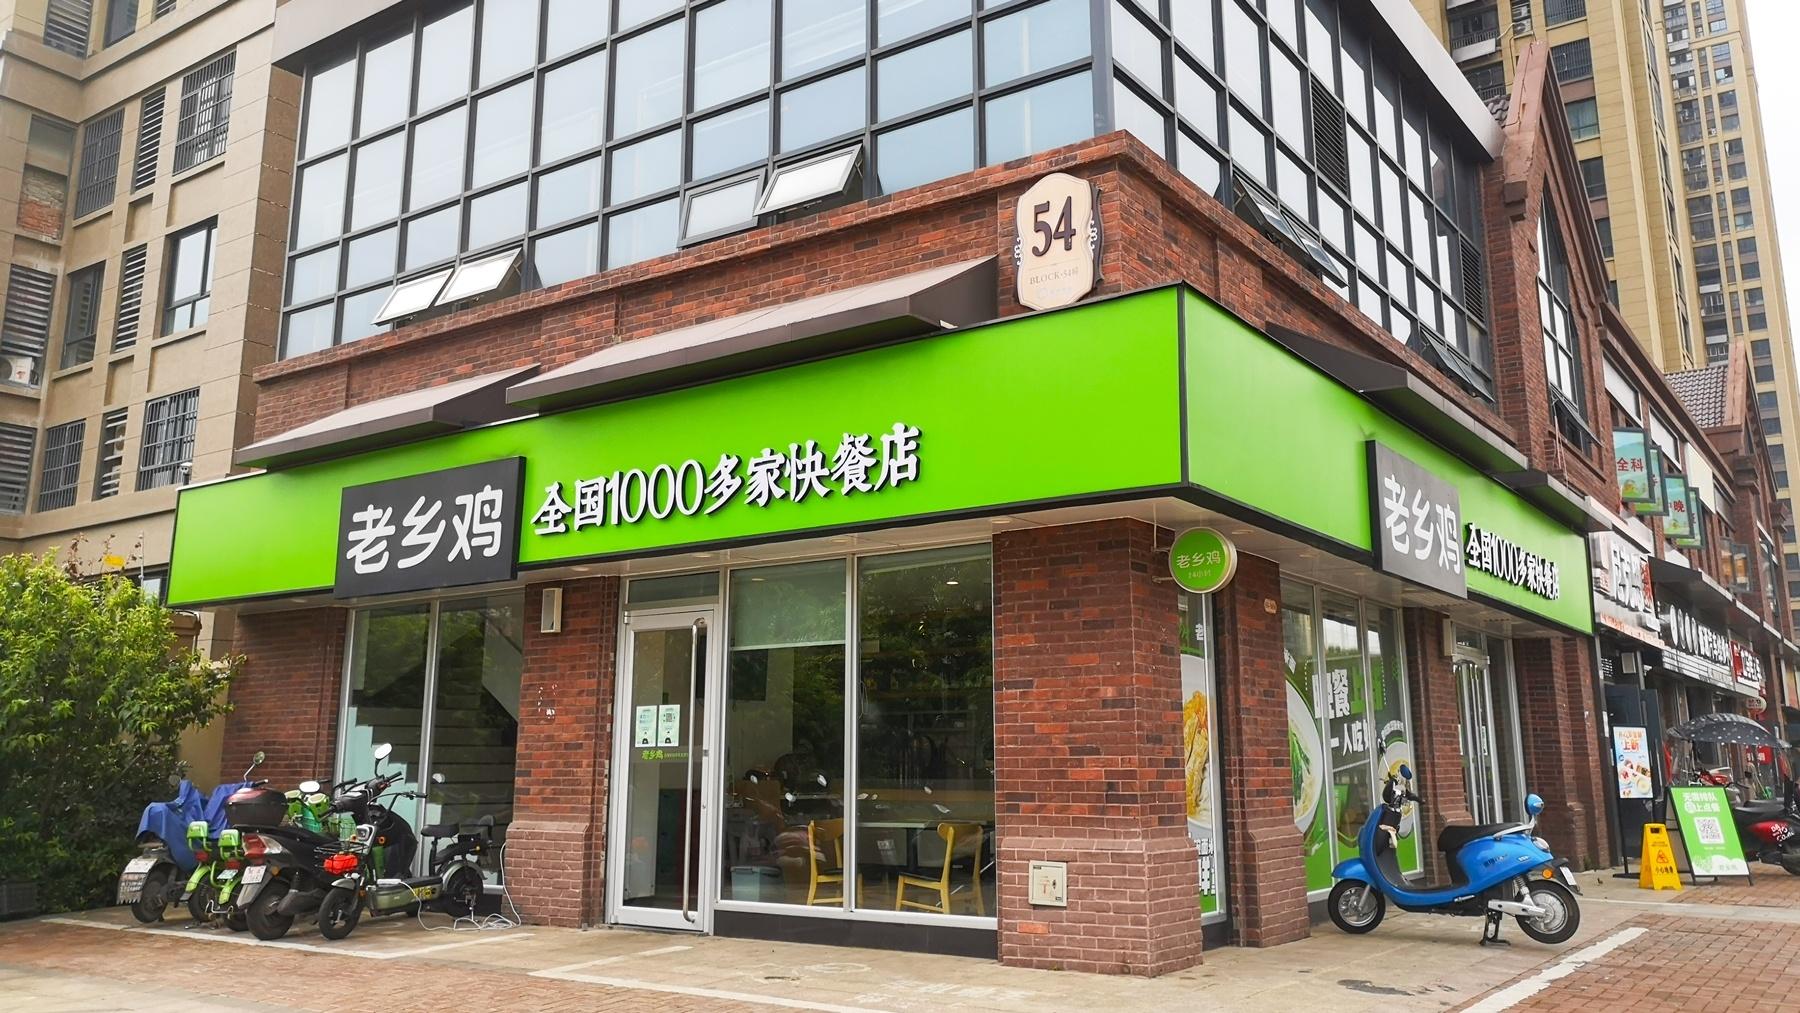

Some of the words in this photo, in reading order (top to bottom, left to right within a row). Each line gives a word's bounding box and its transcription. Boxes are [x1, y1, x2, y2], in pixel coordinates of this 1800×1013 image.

[1031, 195, 1077, 257] 54
[531, 422, 922, 536] 全国1000多家快餐店
[1617, 457, 1643, 472] 全科
[346, 484, 503, 574] 老乡鸡
[1176, 550, 1220, 569] 老乡鸡
[1384, 474, 1461, 575] 老乡鸡
[1466, 522, 1560, 600] 全国1000多家快餐店
